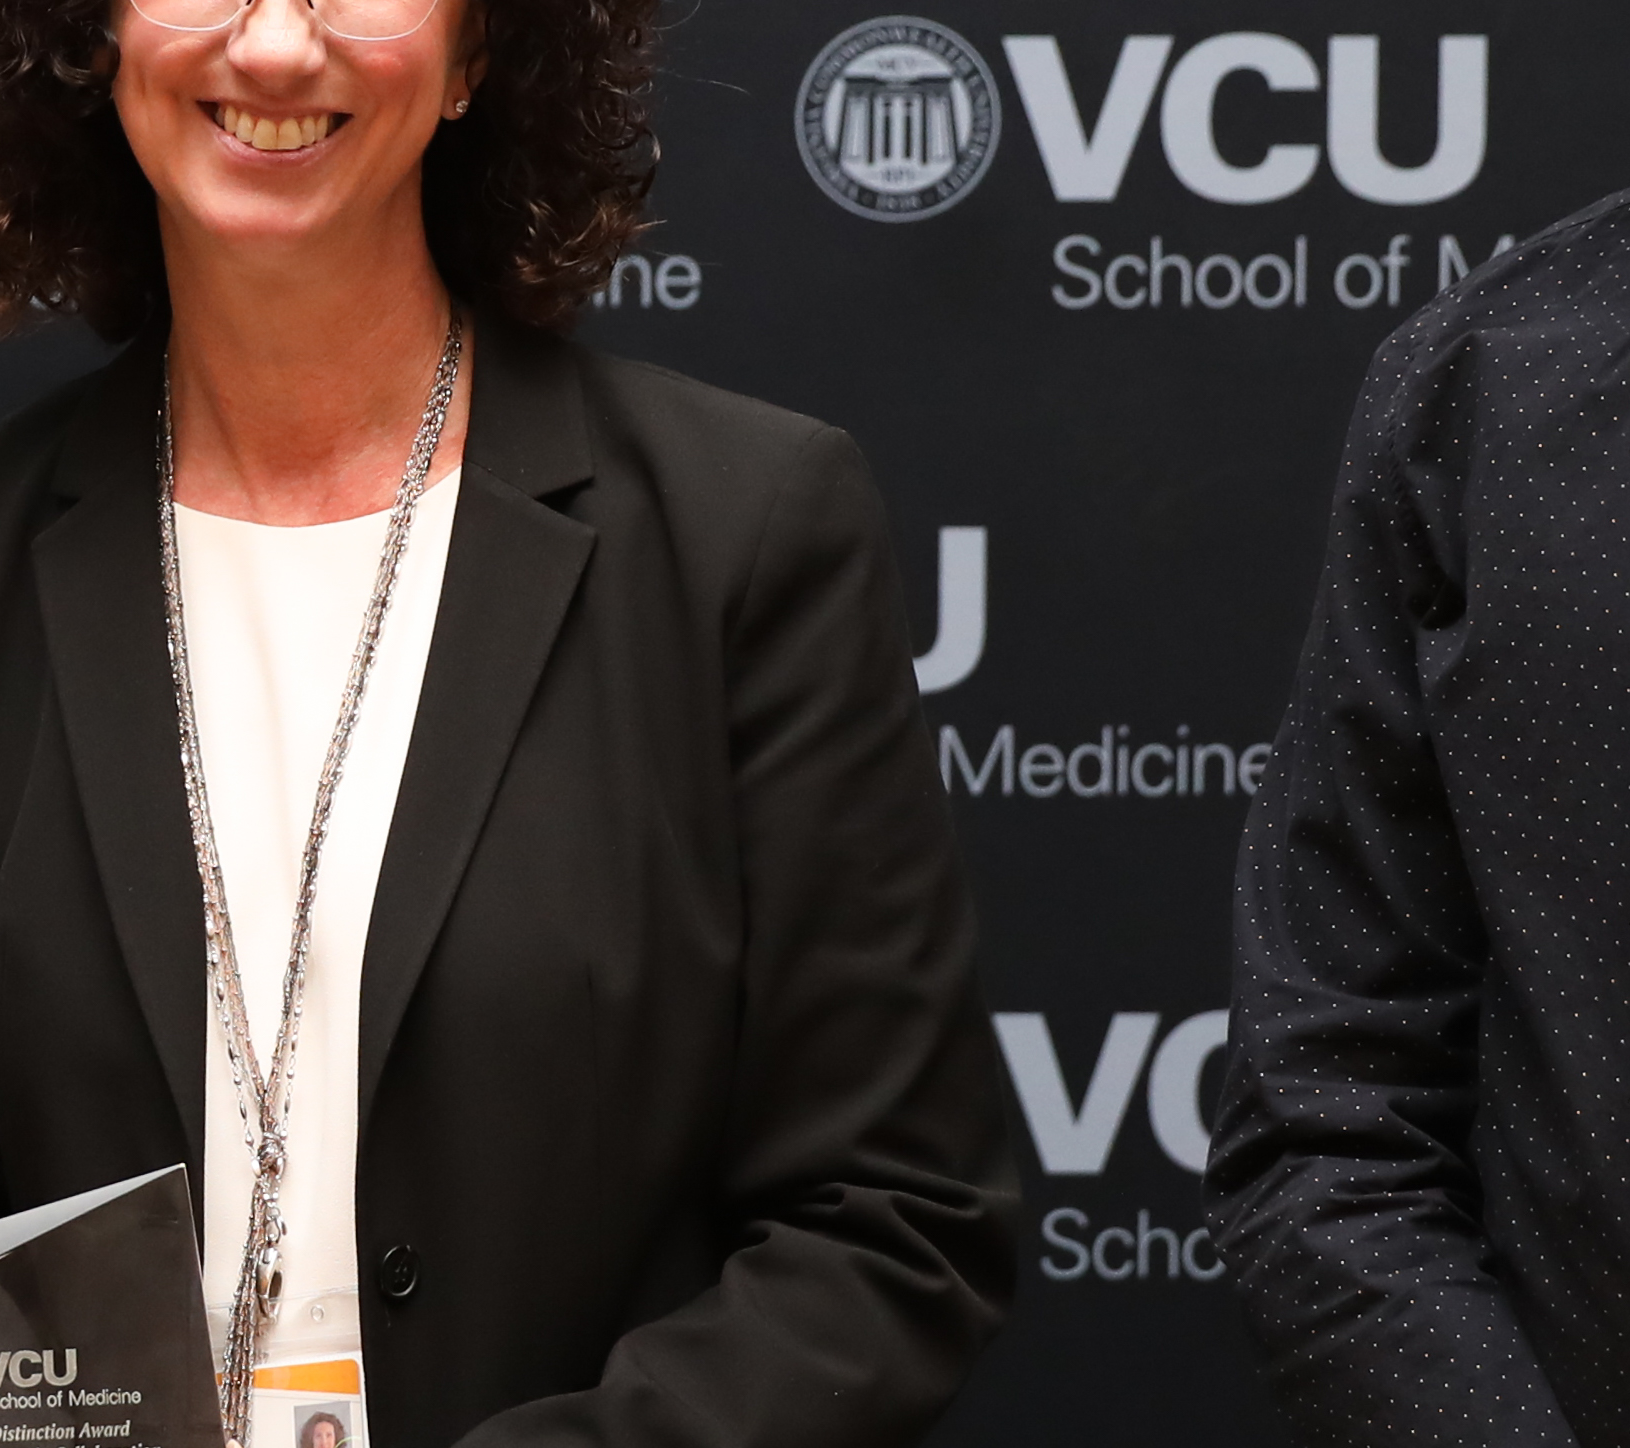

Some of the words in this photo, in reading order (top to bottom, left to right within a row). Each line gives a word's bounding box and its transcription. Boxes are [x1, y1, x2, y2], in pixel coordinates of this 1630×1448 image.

[1002, 32, 1488, 205] VCU
[1053, 235, 1307, 309] School
[1334, 234, 1411, 309] of
[939, 723, 1274, 798] Medicine
[1041, 1206, 1227, 1281] Scho
[47, 1389, 63, 1408] of
[69, 1388, 142, 1407] Medicine
[79, 1420, 131, 1439] Award
